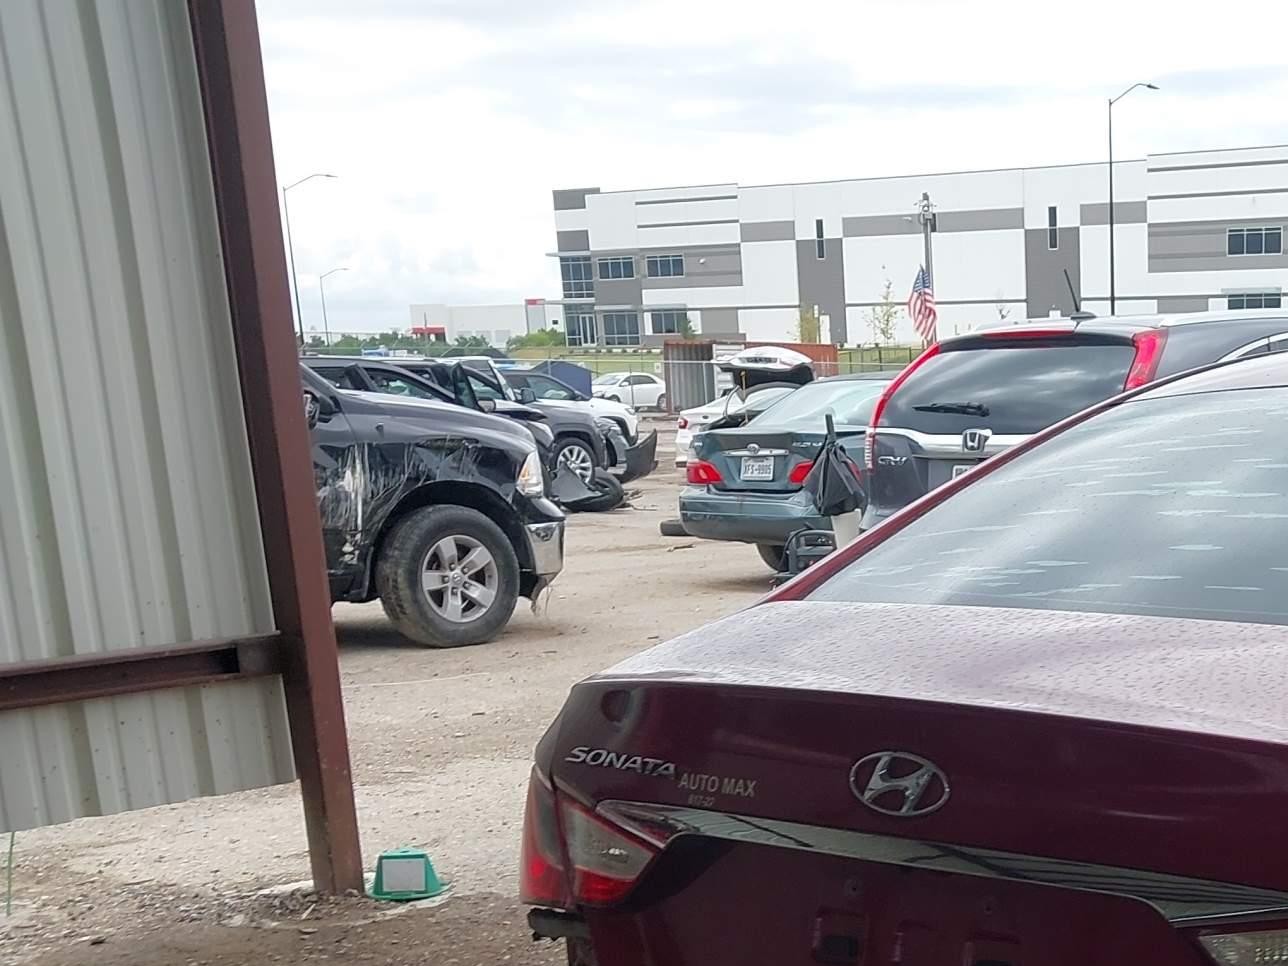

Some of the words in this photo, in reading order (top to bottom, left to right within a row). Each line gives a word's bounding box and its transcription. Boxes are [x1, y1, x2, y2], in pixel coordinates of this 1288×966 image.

[565, 746, 676, 776] SONATA
[677, 773, 720, 793] AUTO
[721, 777, 757, 797] MAX
